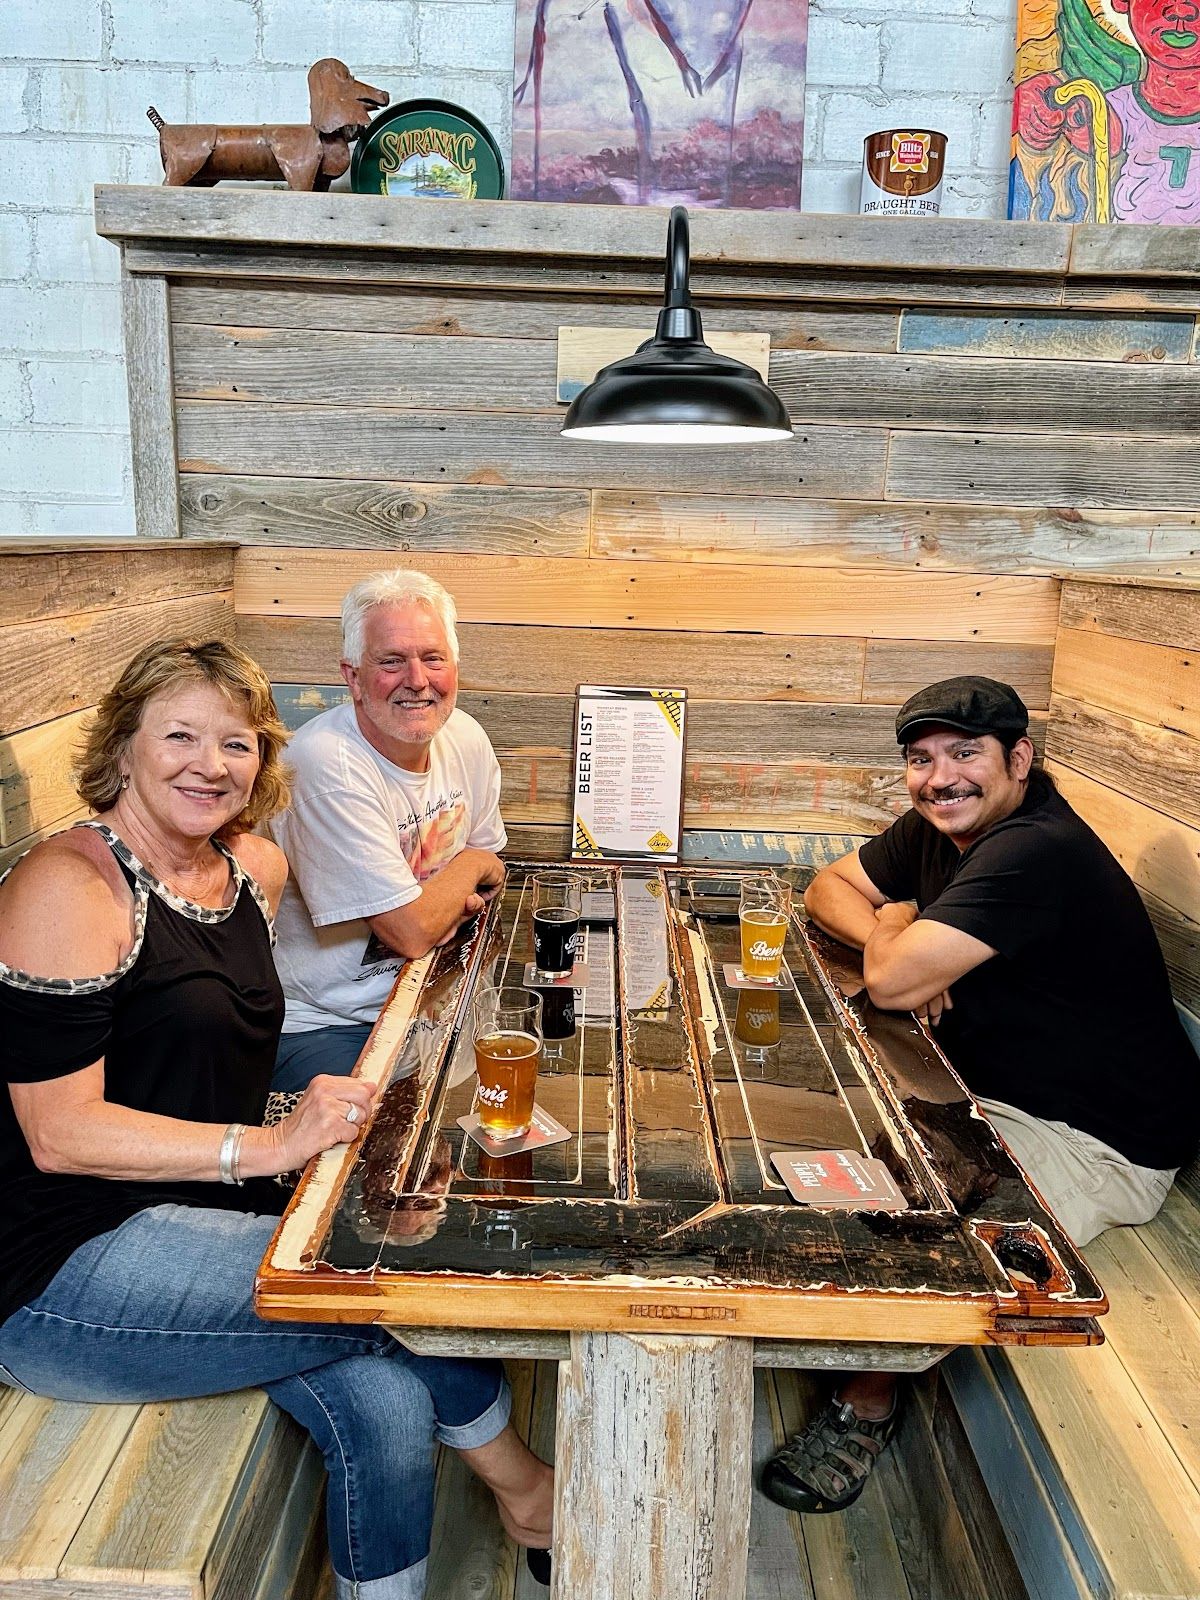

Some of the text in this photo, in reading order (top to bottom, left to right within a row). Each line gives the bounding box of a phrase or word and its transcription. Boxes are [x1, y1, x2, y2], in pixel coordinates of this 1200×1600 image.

[380, 127, 476, 173] SARANAC
[900, 143, 922, 153] Blitz
[1159, 146, 1191, 188] 7
[864, 199, 916, 213] DRAUGHT
[578, 713, 593, 794] BEER LIST
[478, 1084, 509, 1103] en's
